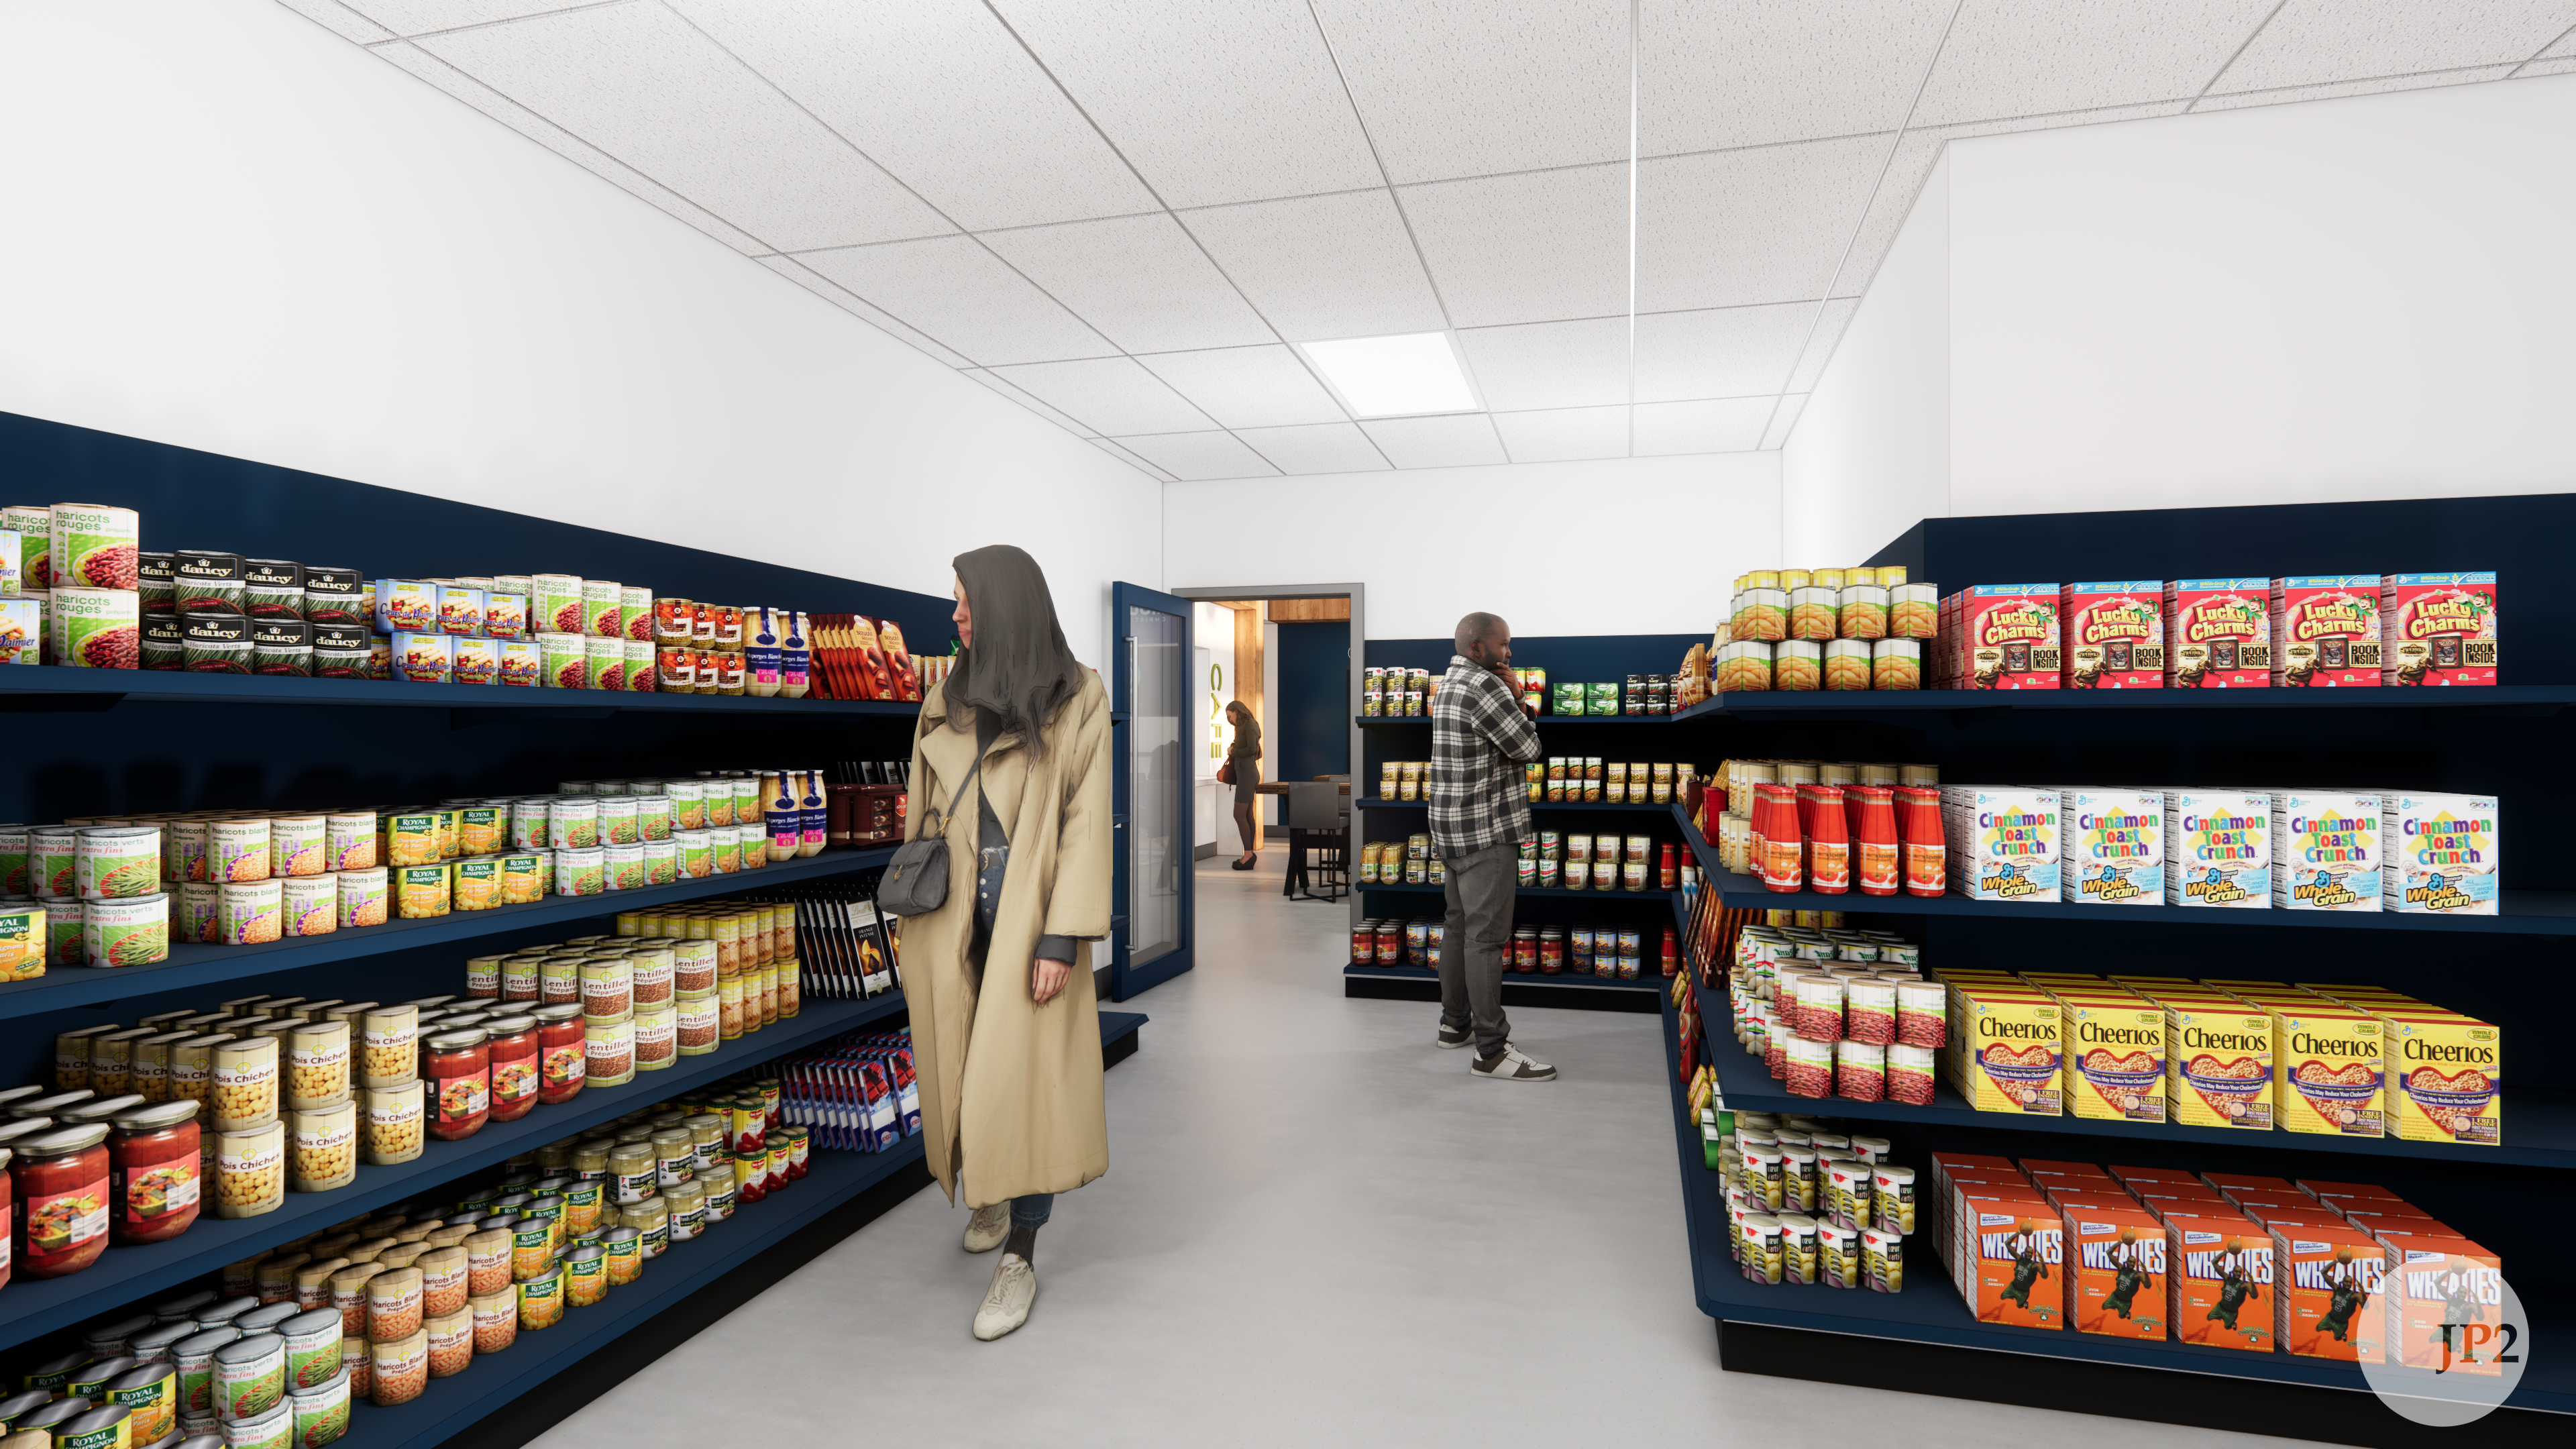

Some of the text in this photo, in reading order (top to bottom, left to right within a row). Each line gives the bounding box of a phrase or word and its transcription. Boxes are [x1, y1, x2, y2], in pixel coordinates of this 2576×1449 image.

[56, 511, 110, 523] haricots
[56, 519, 101, 531] rouges
[537, 578, 571, 588] haricots
[537, 585, 567, 594] rouges
[56, 594, 110, 606] haricots
[56, 603, 101, 614] rouges
[2092, 605, 2143, 626] Lucky
[2196, 604, 2247, 623] Lucky
[2303, 600, 2357, 621] Lucky
[2419, 599, 2471, 619] Lucky
[1991, 608, 2038, 627] Lucky
[1986, 625, 2046, 644] Charms
[2086, 623, 2148, 643] Charms
[2190, 622, 2255, 641] Charms
[2299, 619, 2365, 639] Charms
[2412, 617, 2480, 637] Charms
[2033, 650, 2059, 659] BOOK
[2135, 648, 2163, 658] BOOK
[2241, 647, 2268, 656] BOOK
[2351, 645, 2380, 655] BOOK
[2465, 643, 2496, 653] BOOK
[2033, 659, 2059, 668] INSIDE
[2135, 658, 2163, 667] INSIDE
[2241, 656, 2269, 665] INSIDE
[2351, 655, 2380, 664] INSIDE
[2465, 653, 2496, 663] INSIDE
[1211, 663, 1222, 759] CAFE
[669, 789, 694, 798] salsifis
[1980, 812, 2055, 828] Cinnamon
[2080, 813, 2158, 830] Cinnamon
[2184, 815, 2265, 832] Cinnamon
[2292, 816, 2377, 834] Cinnamon
[2404, 818, 2491, 835] Cinnamon
[212, 826, 246, 835] haricots
[1998, 827, 2037, 842] Toast
[2098, 828, 2140, 843] Toast
[2204, 830, 2246, 846] Toast
[82, 838, 144, 847] haricots verts
[677, 838, 702, 846] salsifis
[1992, 841, 2046, 855] Crunch
[2312, 833, 2356, 848] Toast
[2425, 835, 2471, 850] Toast
[103, 847, 123, 855] fins
[2093, 842, 2149, 858] Crunch
[2198, 845, 2255, 860] Crunch
[2306, 846, 2366, 862] Crunch
[2419, 847, 2481, 865] Crunch
[1982, 875, 2025, 891] Whole
[1998, 883, 2036, 897] Grain
[2082, 877, 2126, 893] Whole
[2186, 881, 2233, 896] Whole
[2100, 885, 2139, 901] Grain
[2204, 888, 2245, 903] Grain
[2294, 884, 2342, 899] Whole
[2313, 891, 2354, 906] Grain
[2407, 887, 2455, 903] Whole
[2426, 894, 2469, 910] Grain
[851, 904, 867, 916] Lindt
[859, 931, 874, 939] INTENSE
[584, 977, 629, 989] Lentilles
[589, 986, 625, 996] Préparées
[1980, 1017, 2056, 1040] Cheerios
[2080, 1022, 2159, 1045] Cheerios
[365, 1031, 415, 1044] Pois Chiches
[585, 1039, 631, 1051] Lentilles
[2184, 1028, 2266, 1051] Cheerios
[2292, 1033, 2377, 1057] Cheerios
[292, 1050, 347, 1064] Pois Chiches
[591, 1049, 626, 1057] Préparées
[2404, 1039, 2493, 1063] Cheerios
[215, 1067, 274, 1083] Pois Chiches
[2410, 1092, 2428, 1102] Cheerios
[2464, 1096, 2489, 1104] Cholesterol!
[220, 1152, 280, 1170] Pois Chiches
[516, 1236, 547, 1246] CHAMPIGNON
[522, 1232, 543, 1242] ROYAL
[1981, 1229, 2063, 1265] WHEATIES
[2082, 1238, 2166, 1275] WHEATIES
[2186, 1248, 2273, 1285] WHEATIES
[2294, 1257, 2385, 1295] WHEATIES
[526, 1287, 557, 1297] CHAMPIGNON
[531, 1282, 553, 1292] ROYAL
[2406, 1268, 2501, 1305] WHEATIES
[373, 1299, 402, 1308] Haricots
[388, 1302, 411, 1312] Préparés
[219, 1356, 273, 1373] haricots verts
[377, 1362, 407, 1371] Haricots
[392, 1364, 416, 1375] Préparés
[240, 1371, 255, 1379] fins
[121, 1387, 154, 1401] ROYAL
